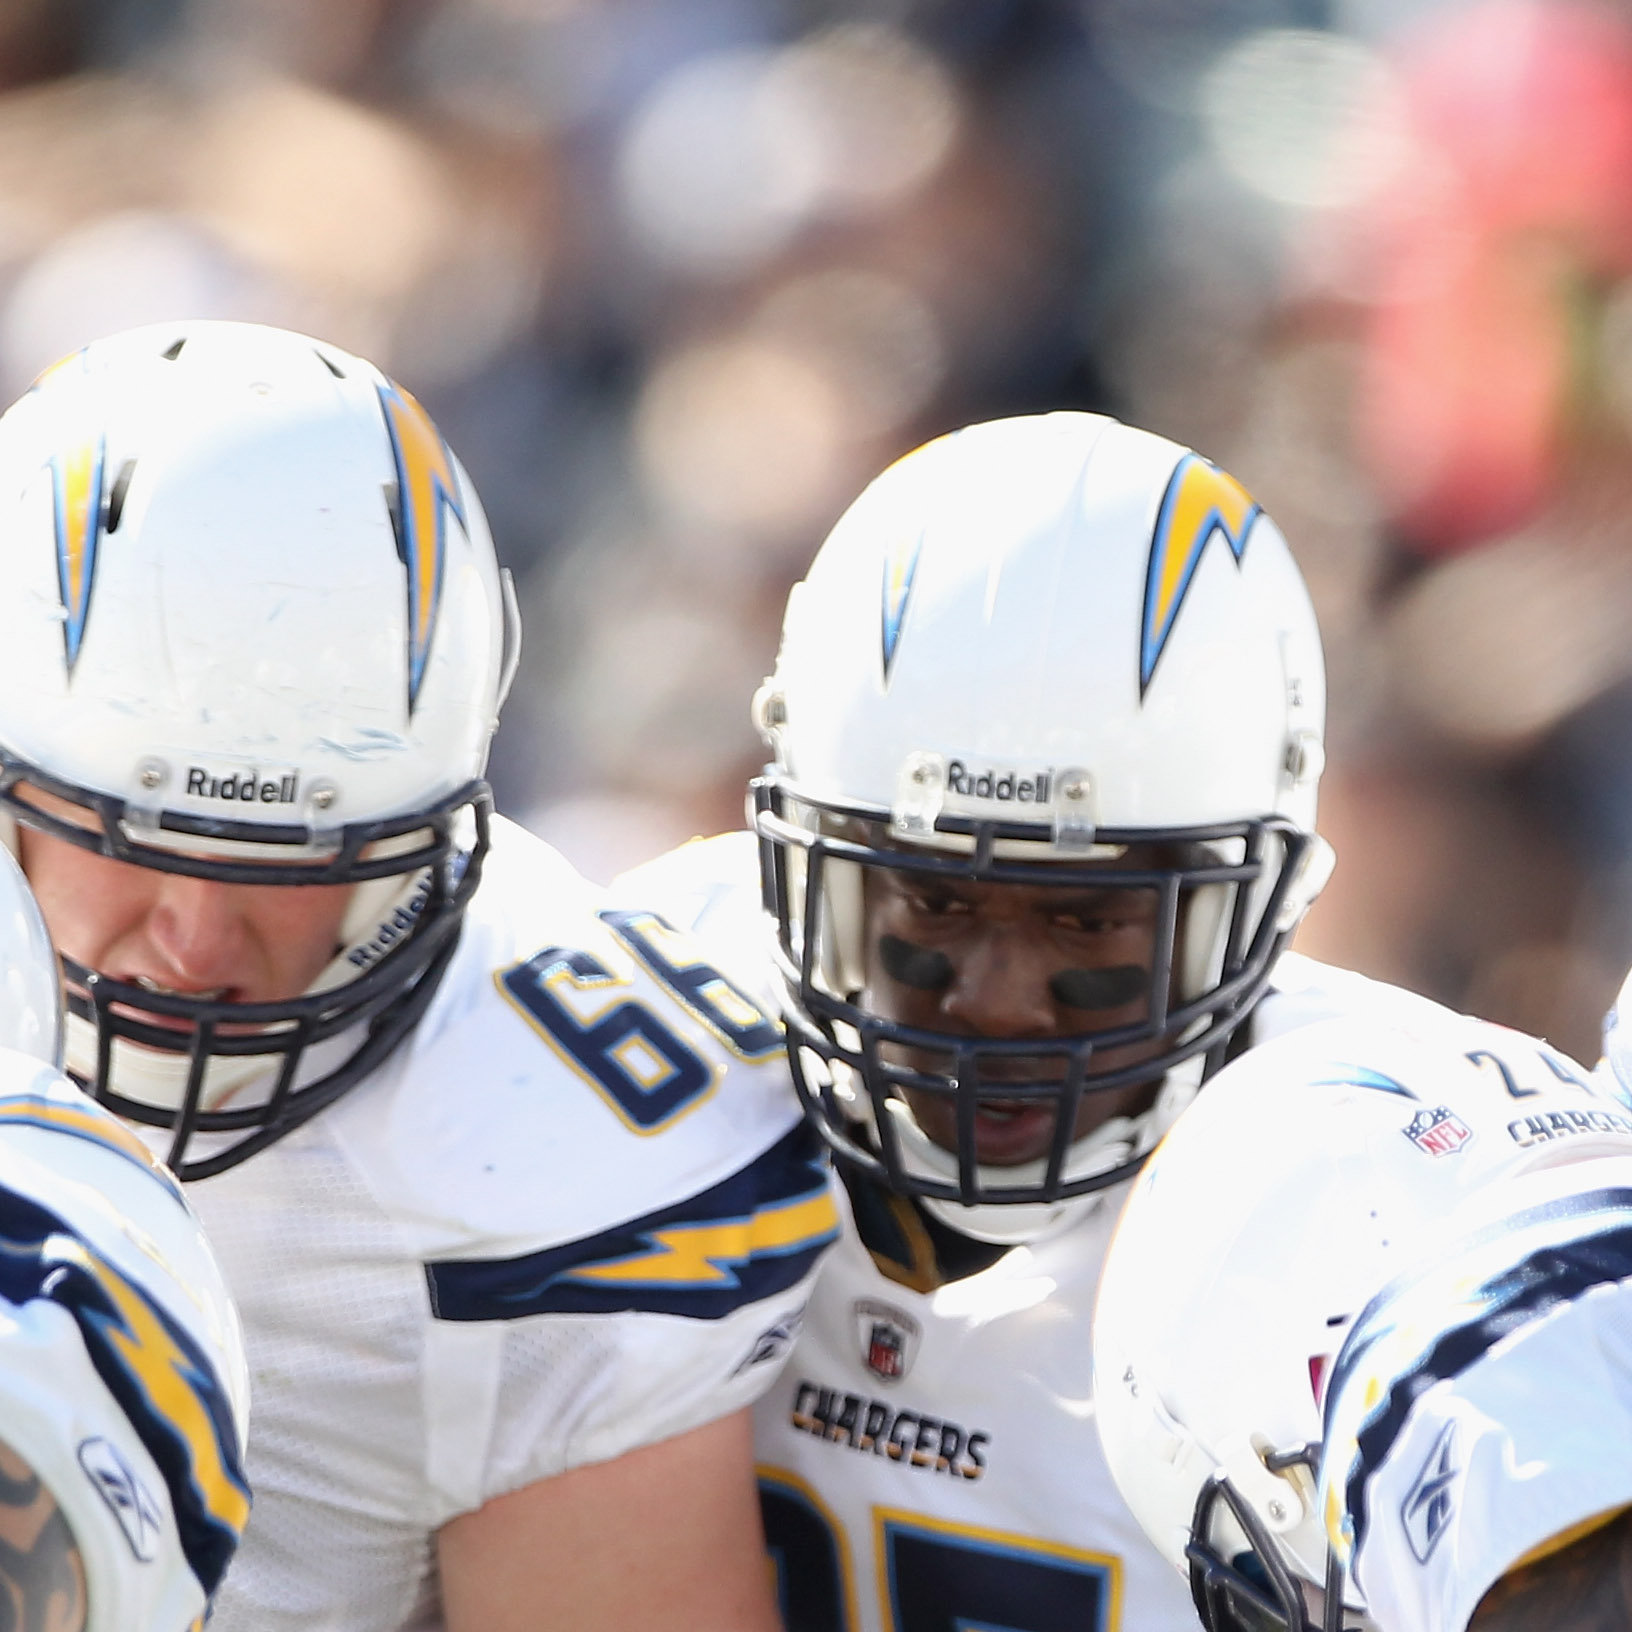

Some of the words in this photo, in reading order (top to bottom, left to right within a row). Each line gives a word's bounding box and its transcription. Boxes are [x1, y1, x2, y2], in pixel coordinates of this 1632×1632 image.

[186, 766, 299, 804] Riddell
[947, 760, 1052, 803] Riddell
[1418, 1114, 1472, 1158] NFL
[792, 1380, 990, 1479] CHARGERS
